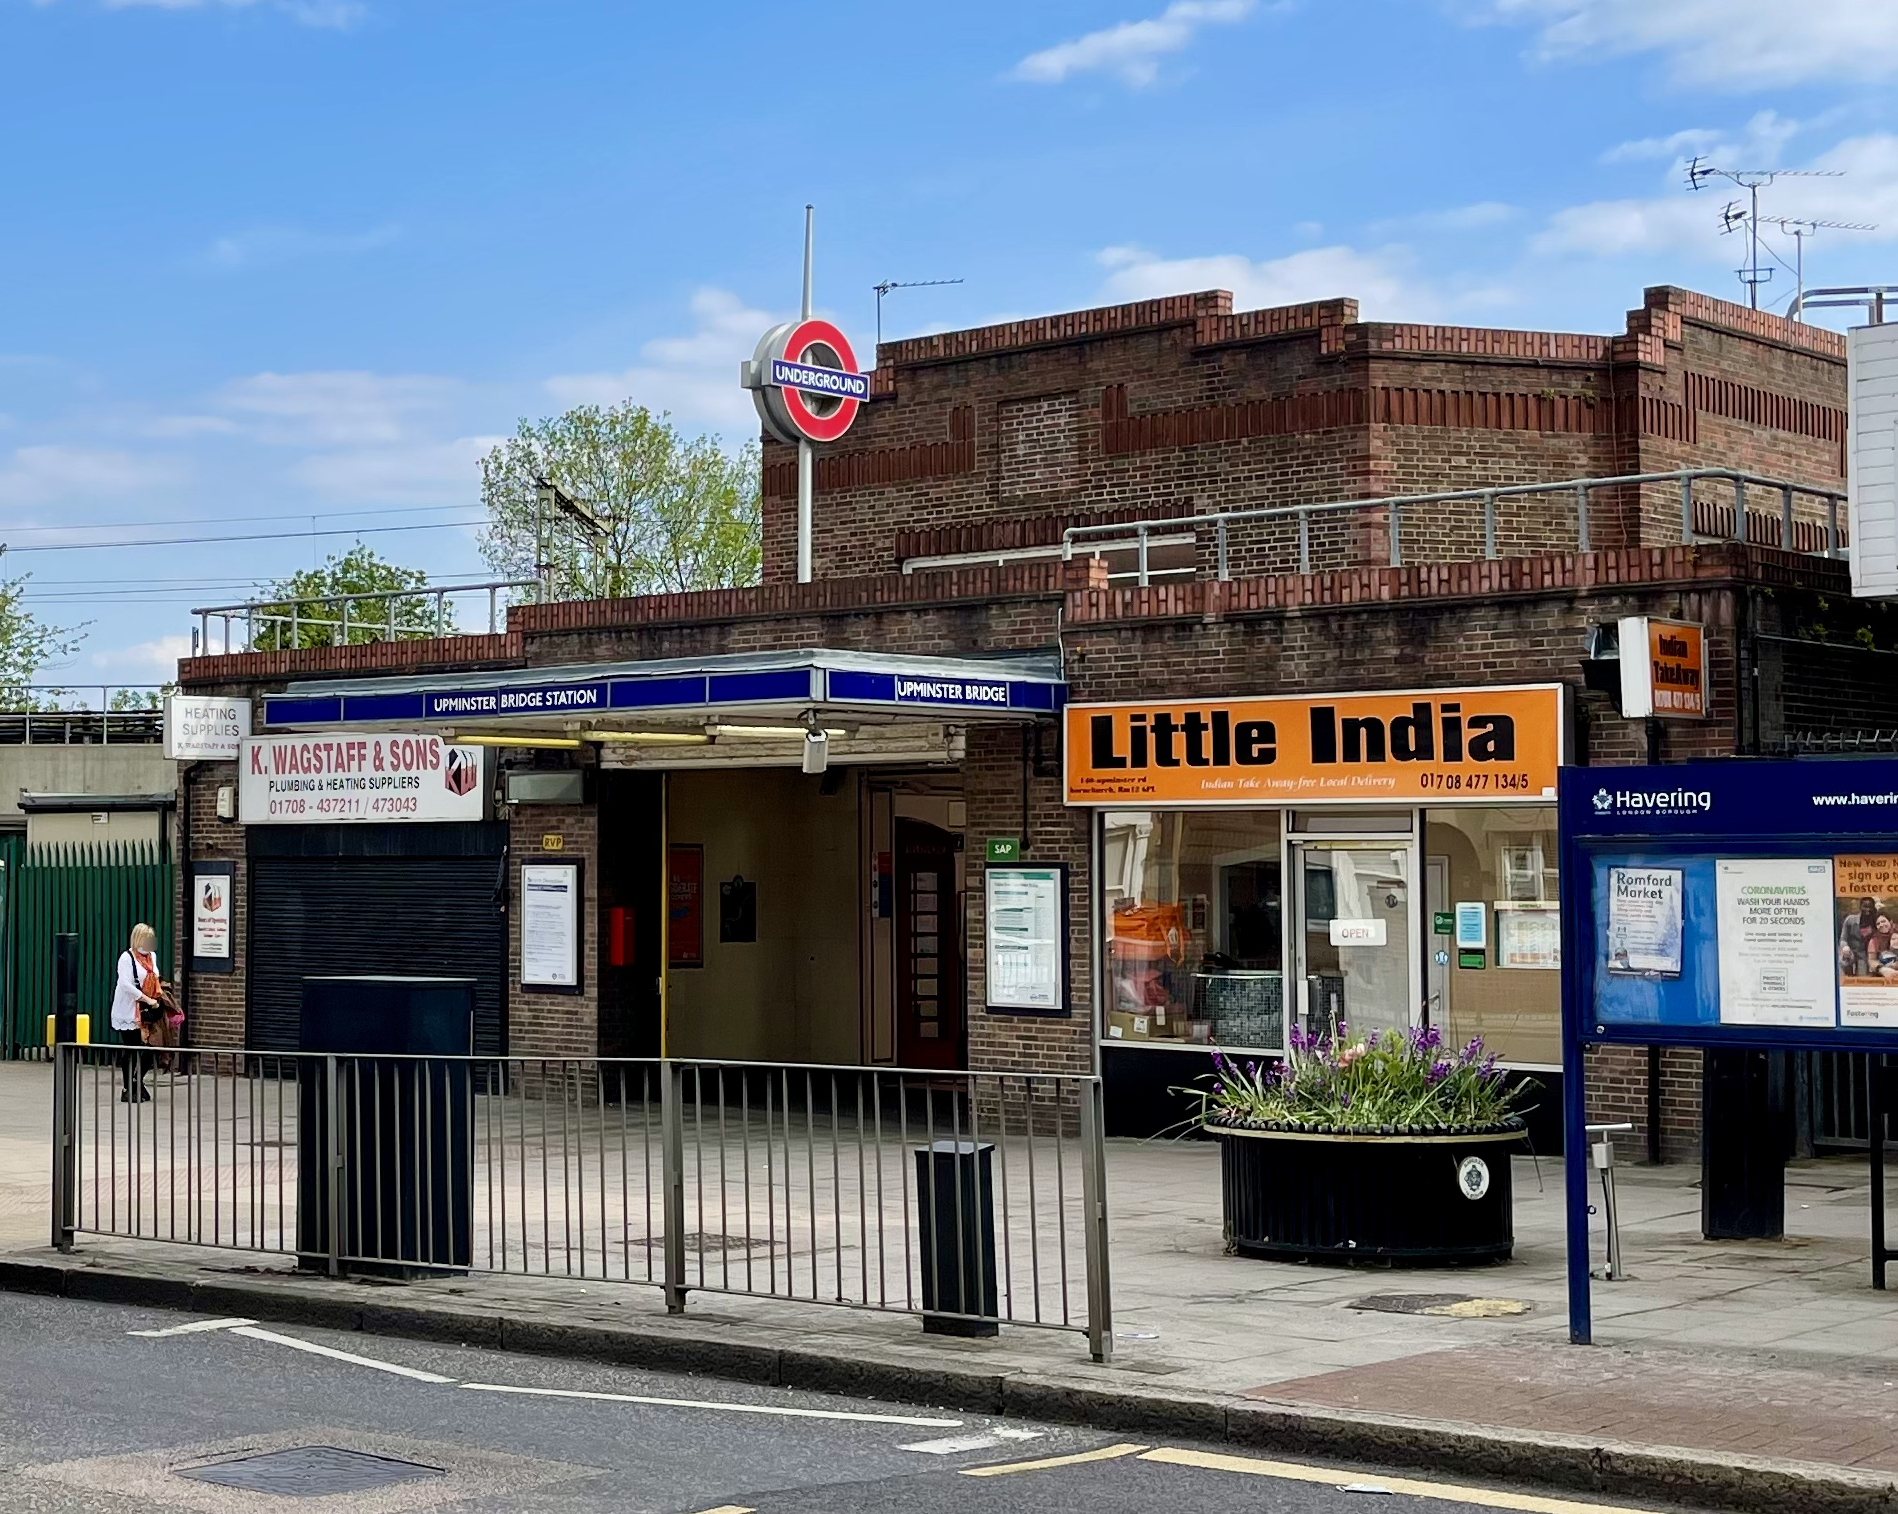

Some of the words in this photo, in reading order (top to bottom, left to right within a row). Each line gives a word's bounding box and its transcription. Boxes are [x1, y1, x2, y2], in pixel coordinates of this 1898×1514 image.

[775, 364, 865, 394] UNDERGROUND
[898, 681, 963, 699] UPMINSTER
[965, 685, 1006, 701] BRIDGE
[434, 696, 497, 711] UPMINSTER
[501, 692, 543, 708] BRIDGE
[545, 689, 597, 706] STATION
[184, 708, 236, 720] HEATING
[182, 724, 239, 736] SUPPLIES
[1090, 709, 1277, 769] Little
[1309, 701, 1516, 764] India
[251, 745, 268, 775] K.
[272, 741, 367, 775] WAGSTAFF
[373, 740, 386, 772] &
[389, 738, 440, 772] SONS
[269, 779, 316, 793] PLUMBING
[317, 779, 324, 791] &
[326, 777, 366, 791] HEATING
[368, 776, 420, 790] SUPPLIERS
[1200, 778, 1234, 789] Indian
[1237, 777, 1261, 789] Take
[1319, 774, 1348, 787] Local
[1351, 773, 1396, 788] Delivery
[1465, 774, 1489, 789] 477
[1493, 773, 1529, 791] 134/5
[269, 799, 306, 815] 01708
[316, 798, 360, 814] 437211
[372, 796, 418, 813] 473043
[1616, 787, 1711, 811] Havering
[544, 837, 562, 848] RVP
[994, 844, 1012, 854] SAP
[1838, 858, 1861, 868] New
[1616, 870, 1672, 887] Romford
[1848, 869, 1872, 882] sign
[1875, 871, 1889, 882] up
[1616, 884, 1664, 900] Market
[1740, 886, 1807, 895] CORONAVIRUS
[1840, 885, 1847, 893] a
[1849, 882, 1884, 893] foster
[1736, 898, 1760, 906] WASH
[1761, 898, 1782, 906] YOUR
[1783, 898, 1811, 906] HANDS
[1749, 907, 1772, 916] MORE
[1773, 907, 1798, 916] OFTEN
[1742, 916, 1757, 925] FOR
[1759, 916, 1769, 925] 20
[1770, 917, 1806, 926] SECONDS
[1341, 928, 1370, 939] OPEN
